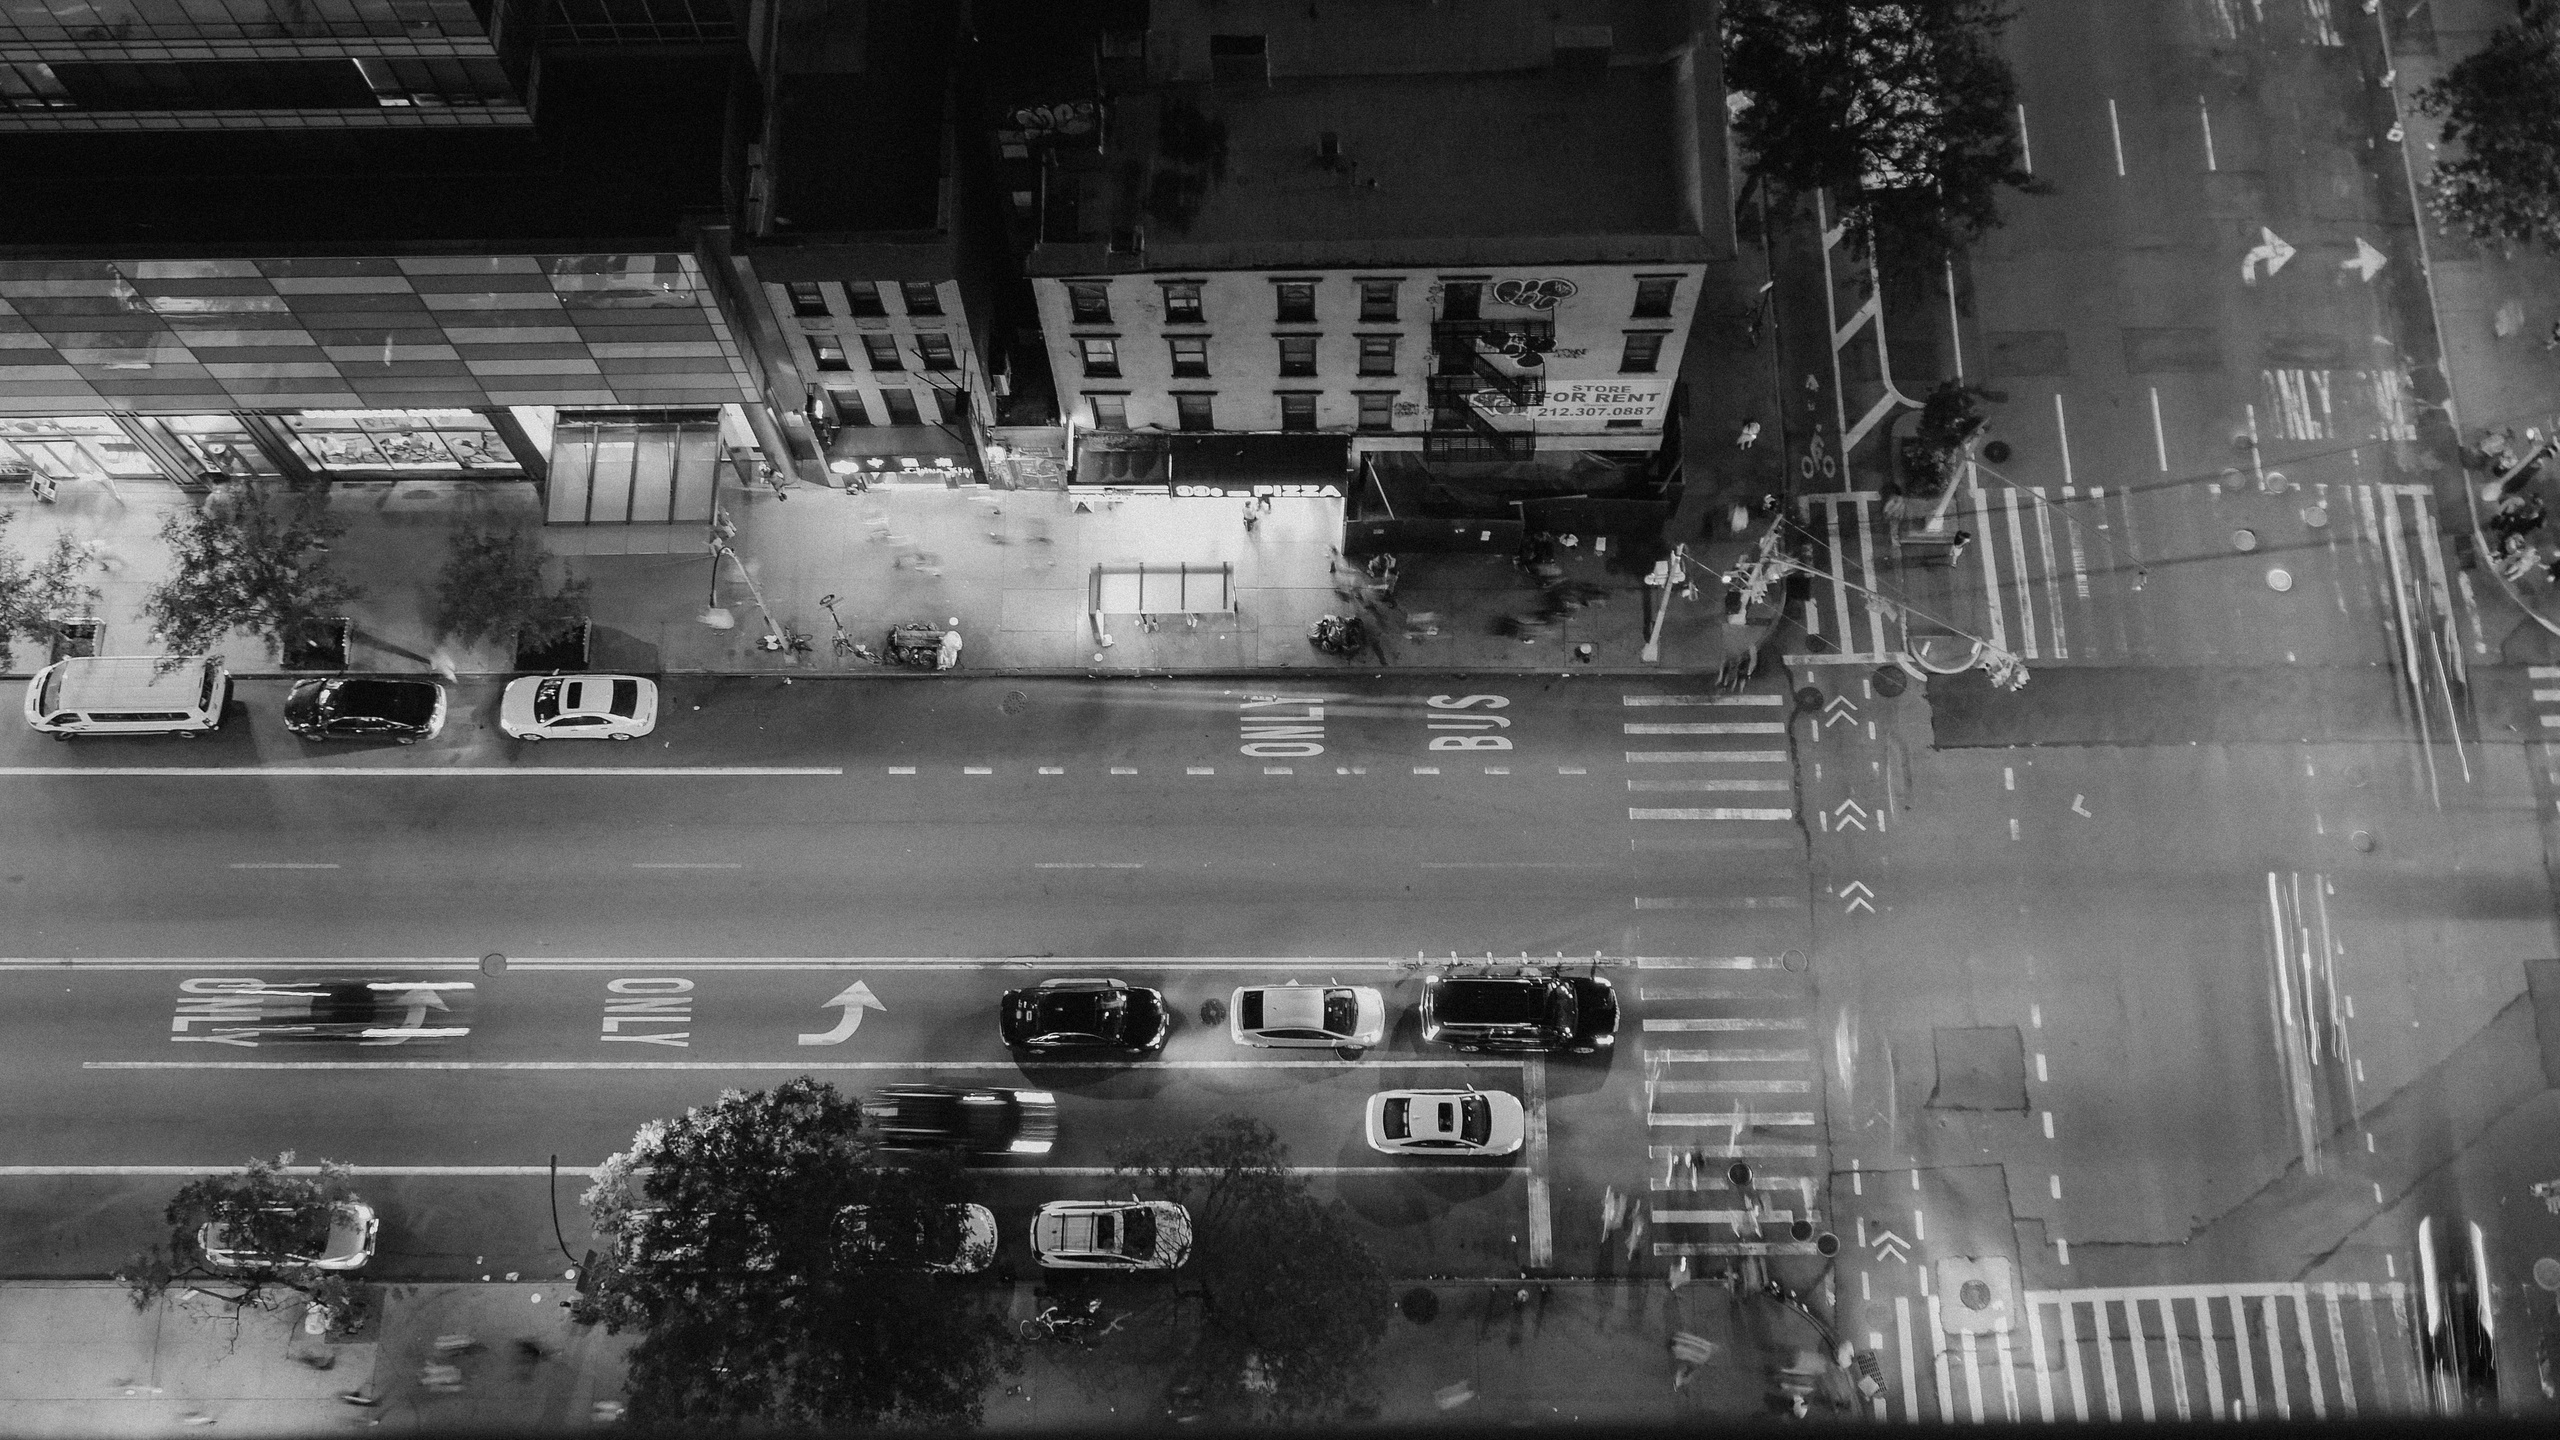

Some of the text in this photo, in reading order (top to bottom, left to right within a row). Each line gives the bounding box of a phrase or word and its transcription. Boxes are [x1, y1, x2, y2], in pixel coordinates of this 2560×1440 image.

[1544, 392, 1661, 403] FOR RENT
[1572, 384, 1632, 394] STORE
[1537, 406, 1656, 417] 212.307.0887
[1253, 484, 1342, 497] PIZZA
[1240, 696, 1325, 757] ONLY
[1426, 694, 1514, 751] BUS
[171, 977, 267, 1048] ONLY
[600, 977, 695, 1048] ONLY
